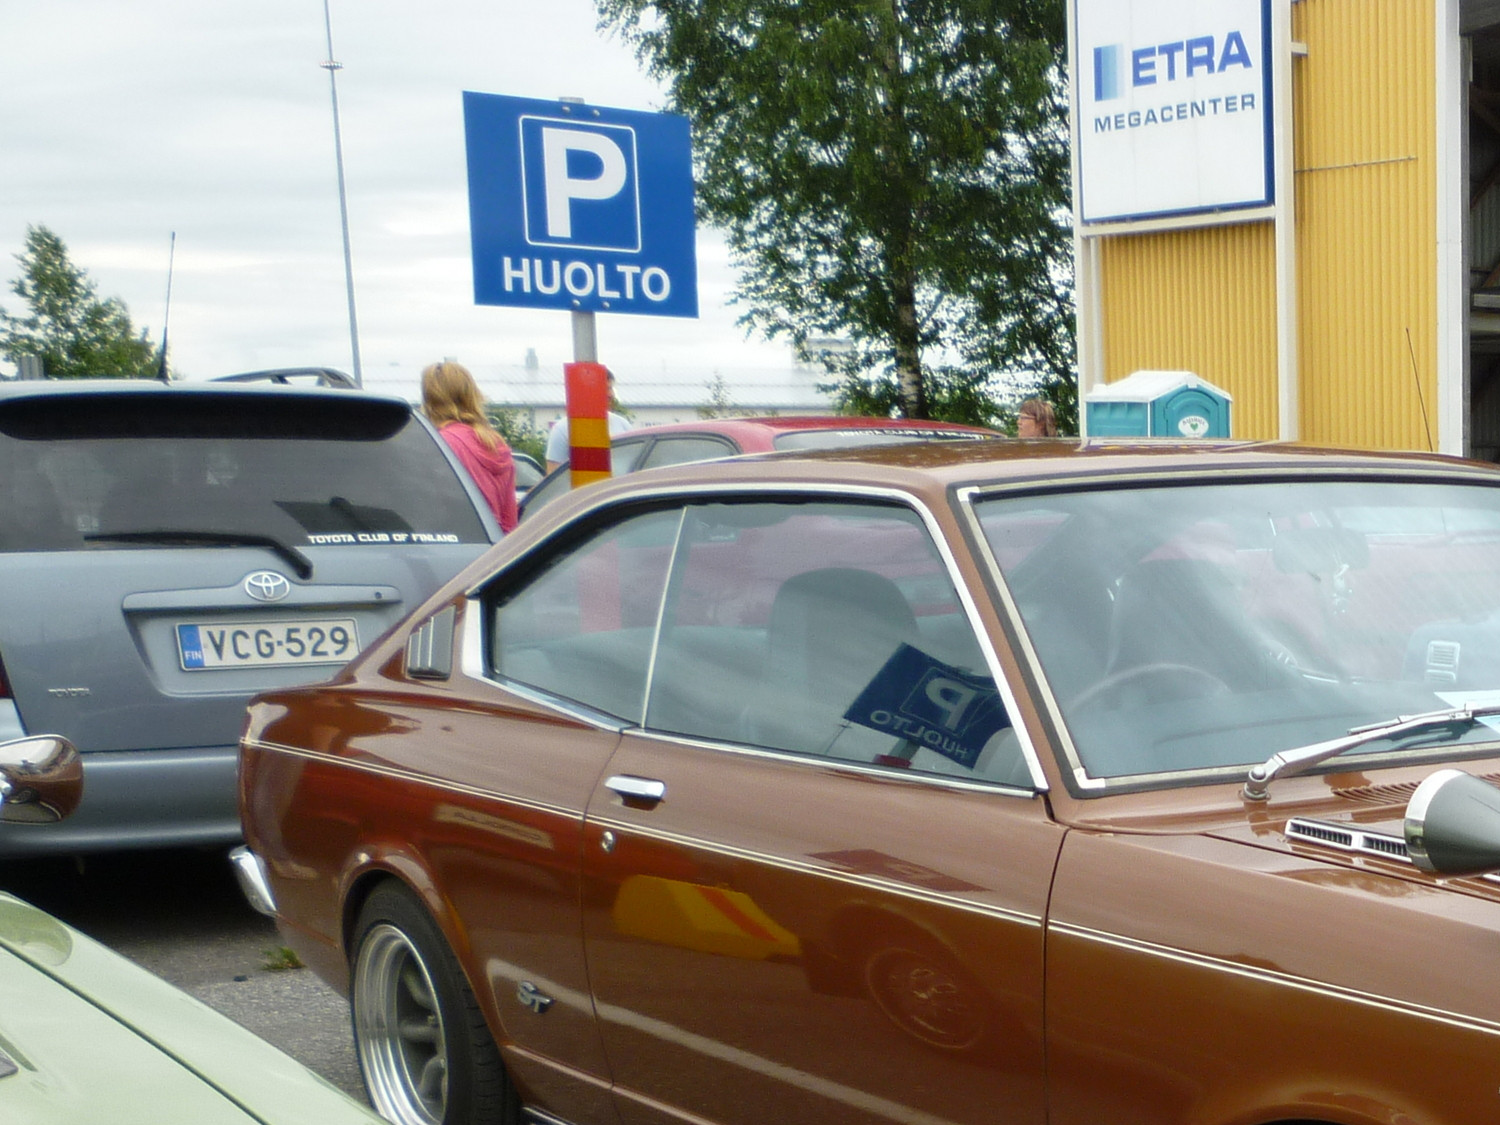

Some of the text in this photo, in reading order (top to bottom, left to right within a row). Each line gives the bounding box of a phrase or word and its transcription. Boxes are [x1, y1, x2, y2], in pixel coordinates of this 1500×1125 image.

[1132, 31, 1252, 87] ETRA
[1094, 93, 1255, 133] MEGACENTER
[542, 127, 627, 238] P
[503, 256, 671, 301] HUOLTO
[308, 532, 460, 545] TOYOTA CLUB OF FINLAND
[185, 650, 202, 660] FIN
[207, 626, 349, 661] VCG-529
[517, 981, 551, 1013] ST
